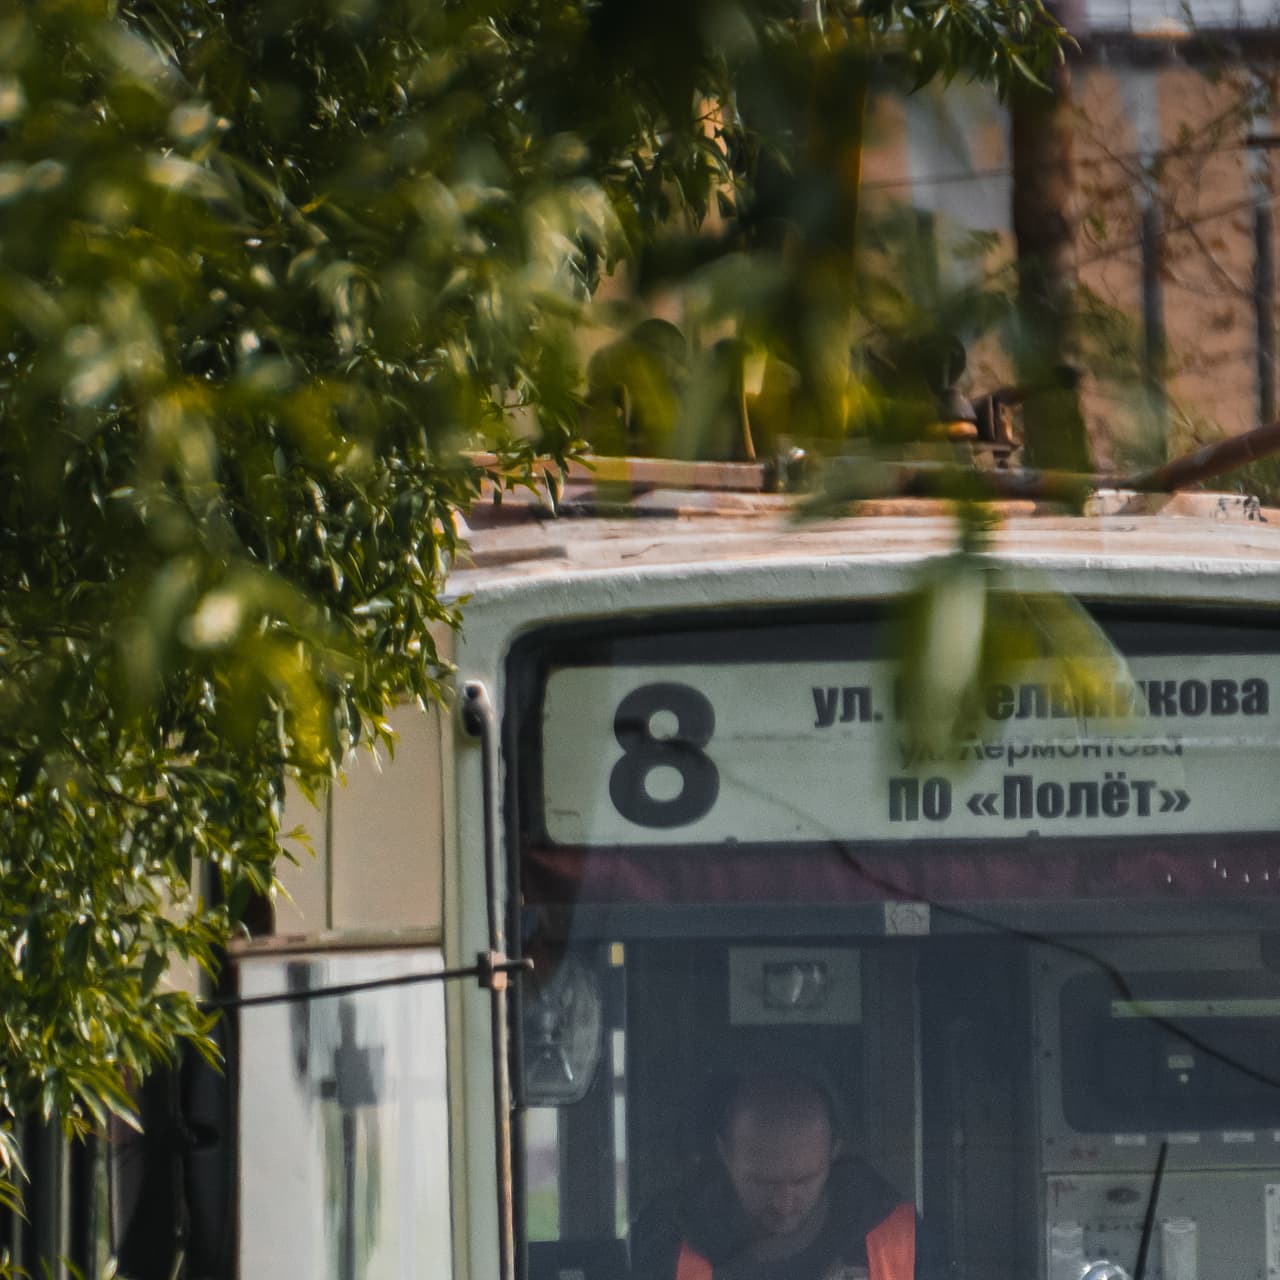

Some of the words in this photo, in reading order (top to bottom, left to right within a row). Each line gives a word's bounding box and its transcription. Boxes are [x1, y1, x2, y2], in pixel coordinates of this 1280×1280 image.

[812, 686, 883, 728] ул.
[609, 682, 720, 829] 8
[888, 776, 952, 822] ПО
[966, 772, 1192, 819] «Полёт»
